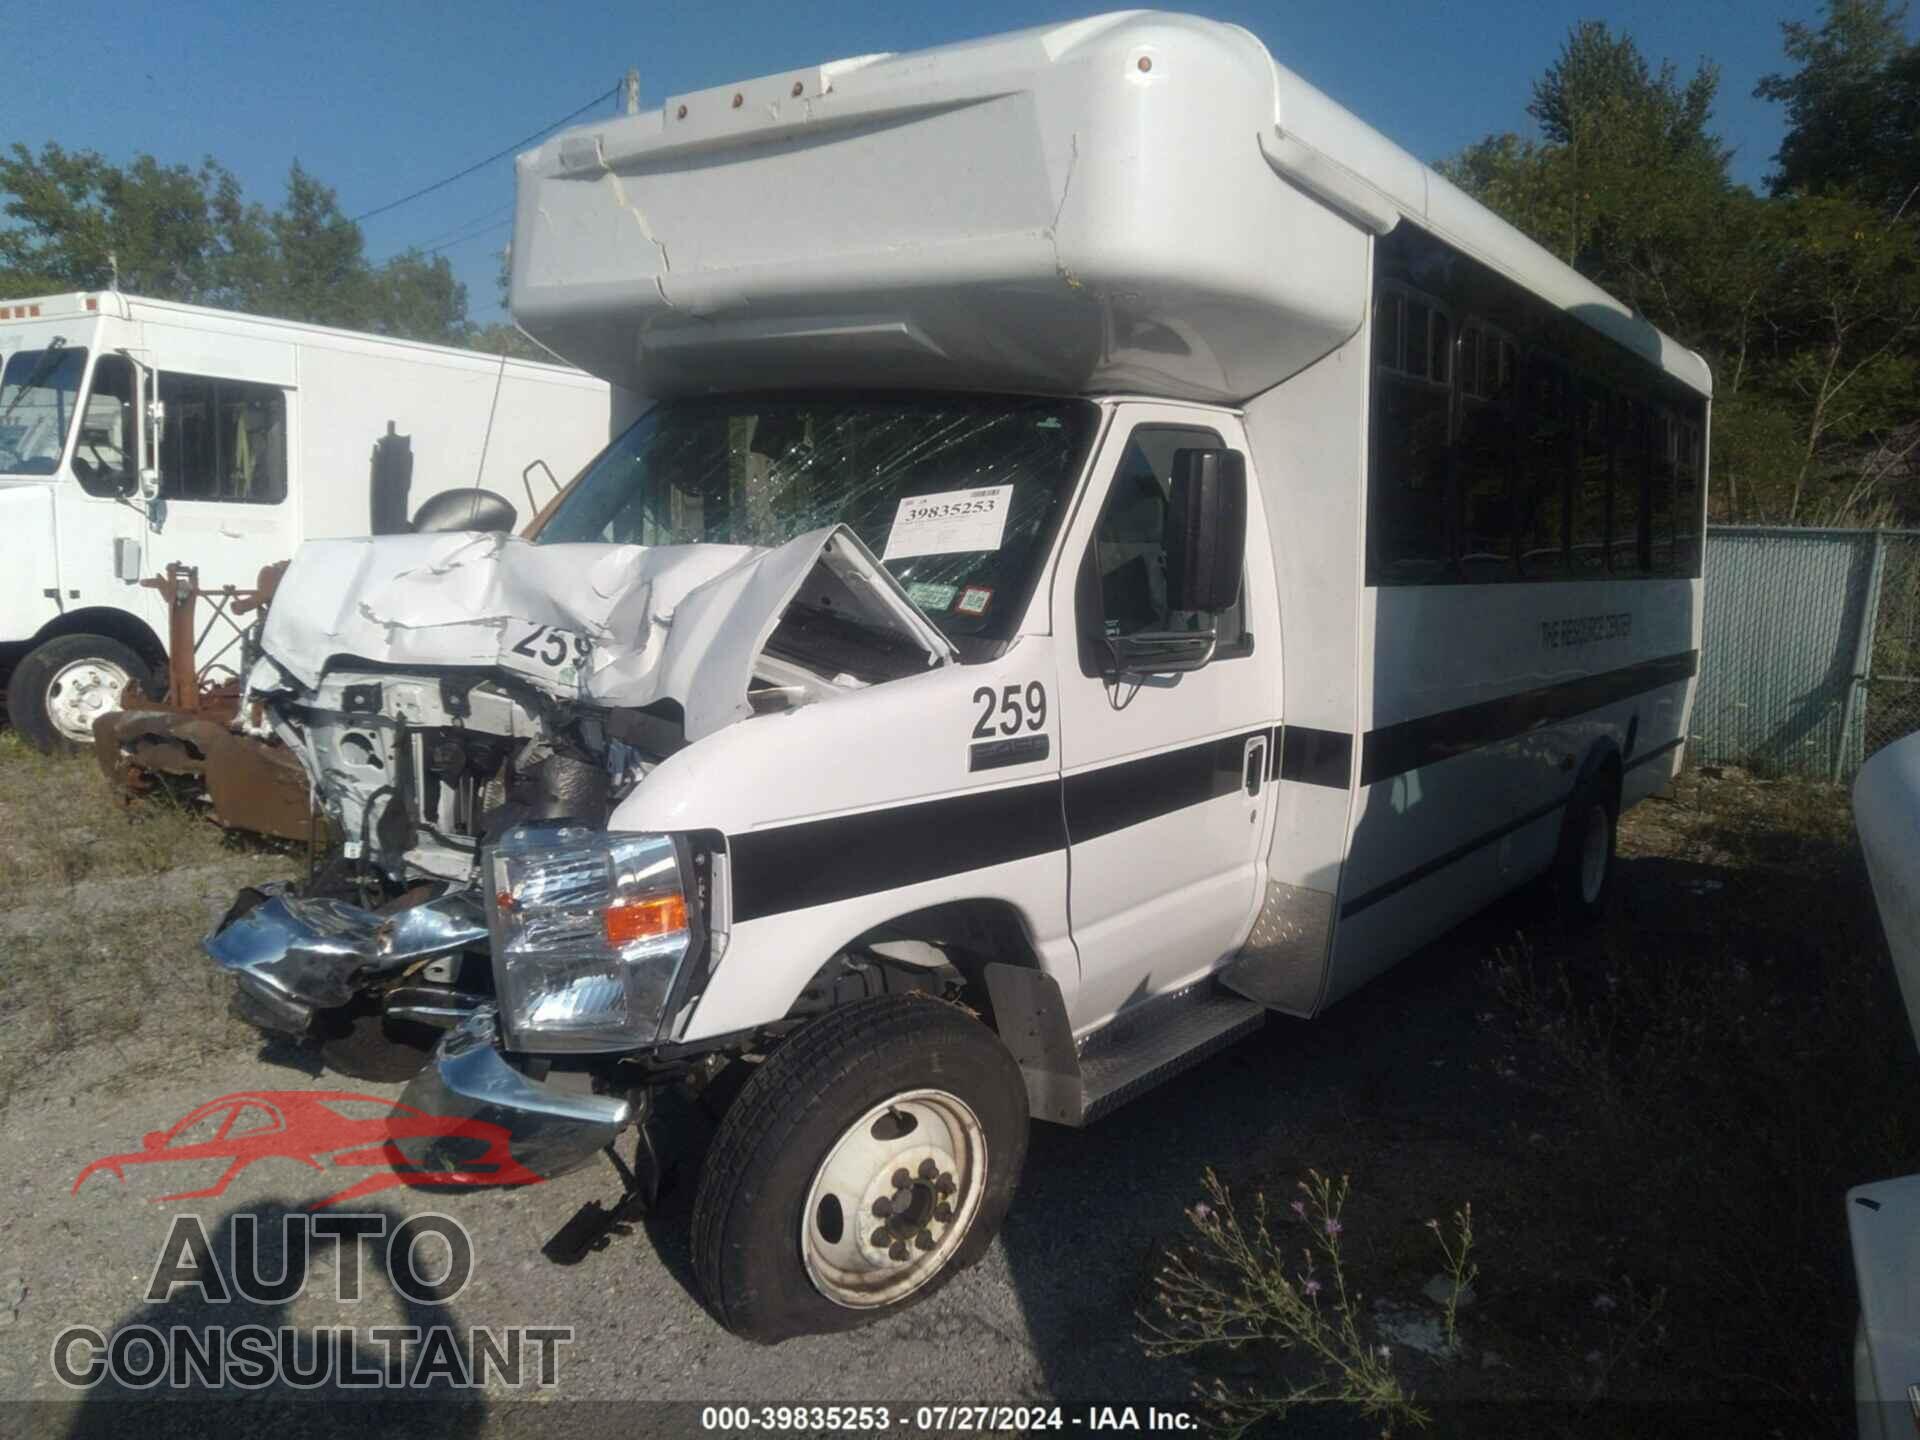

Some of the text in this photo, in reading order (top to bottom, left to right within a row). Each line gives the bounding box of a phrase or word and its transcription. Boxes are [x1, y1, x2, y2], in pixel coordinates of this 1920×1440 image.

[904, 500, 996, 522] 39835253
[511, 621, 593, 670] 259
[971, 680, 1047, 739] 259
